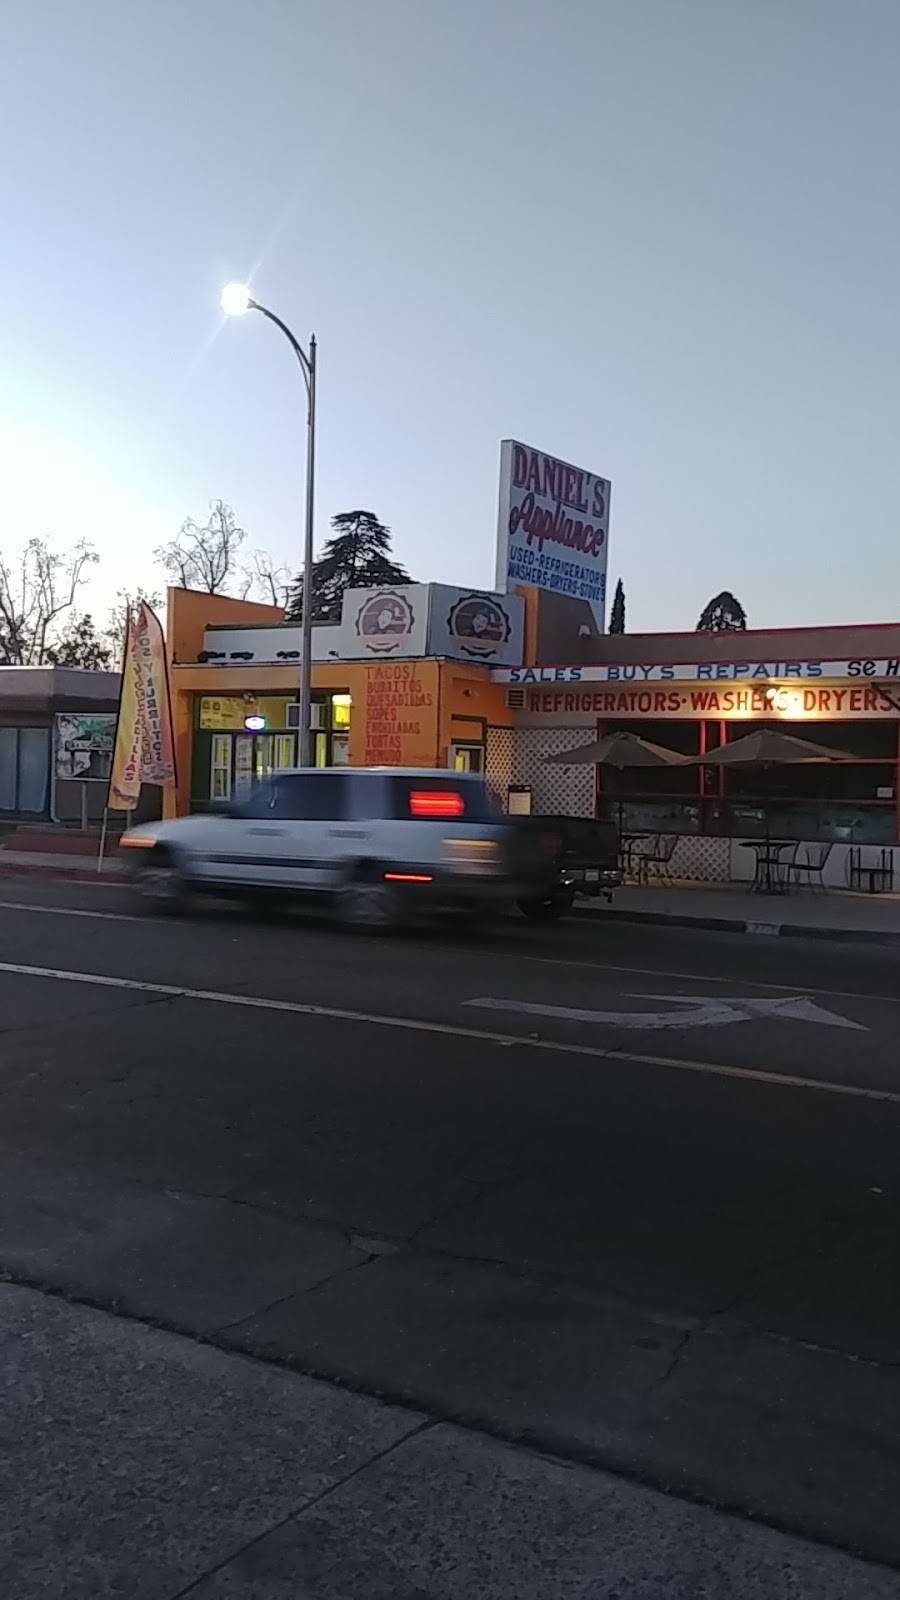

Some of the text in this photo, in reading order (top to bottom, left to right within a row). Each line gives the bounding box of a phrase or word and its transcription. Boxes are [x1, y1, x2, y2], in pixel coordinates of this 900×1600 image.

[512, 444, 605, 518] DANIEL'S
[508, 491, 605, 558] Appliance
[510, 667, 582, 682] SALES
[607, 664, 675, 680] BUYS
[697, 663, 823, 679] REPAIRS
